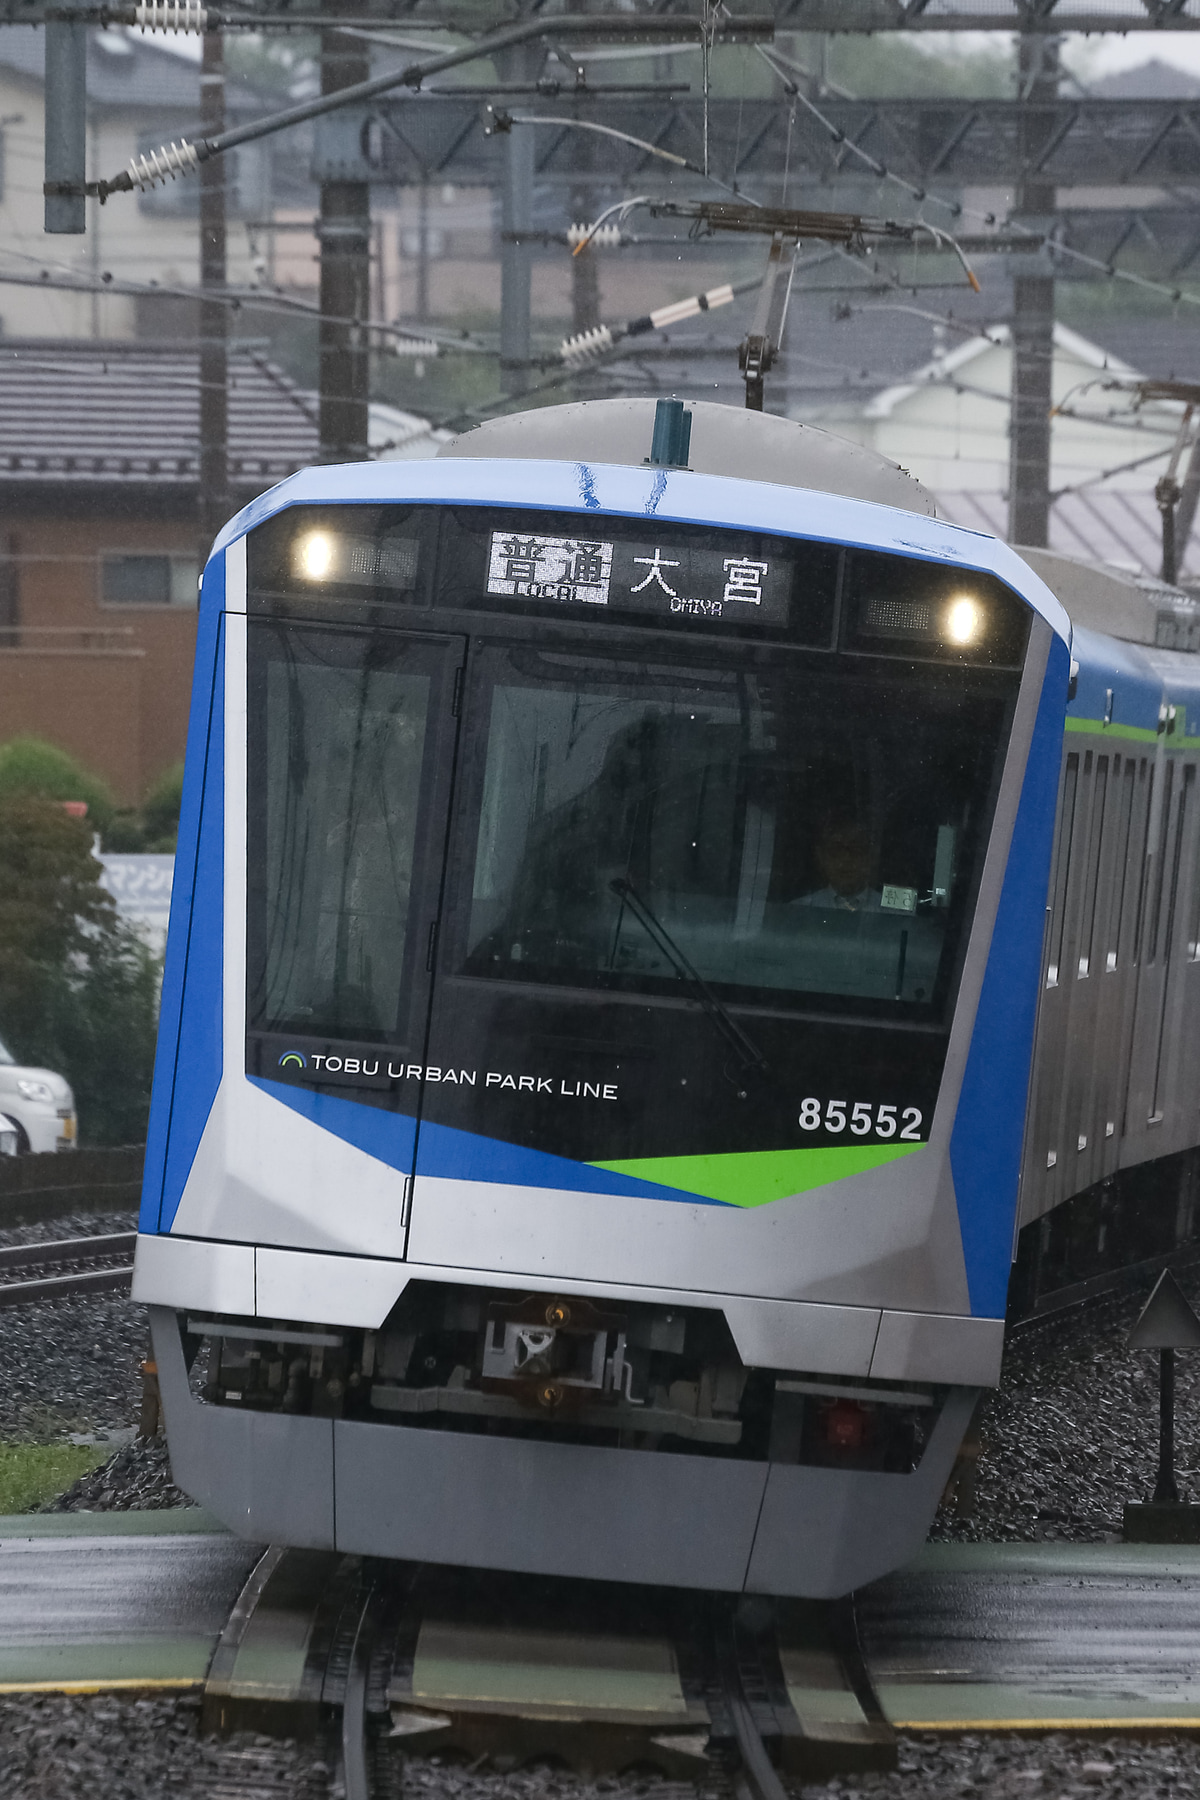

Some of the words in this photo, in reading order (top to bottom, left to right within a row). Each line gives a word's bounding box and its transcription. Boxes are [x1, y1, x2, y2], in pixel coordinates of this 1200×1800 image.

[499, 535, 602, 587] 普通
[630, 547, 769, 605] 大宮
[669, 596, 723, 617] OMIYA
[311, 1054, 380, 1076] TOBU
[387, 1062, 477, 1086] URBAN
[485, 1072, 553, 1094] PARK
[560, 1079, 619, 1101] LINE
[798, 1097, 923, 1141] 85552
